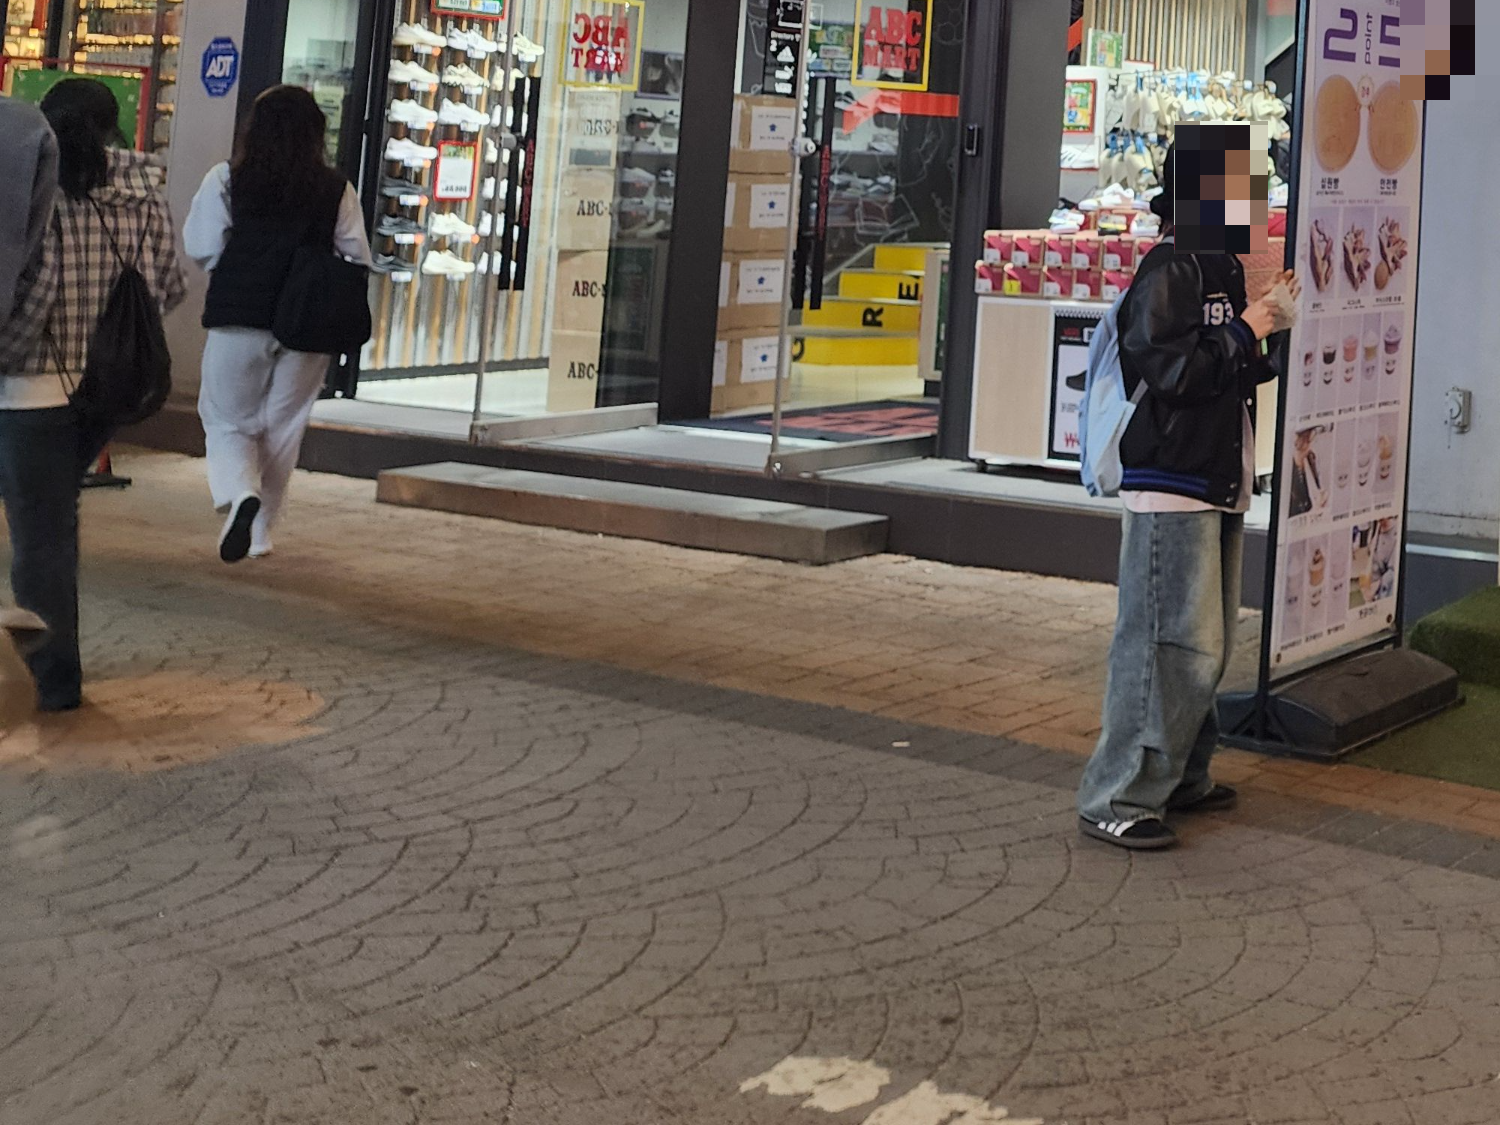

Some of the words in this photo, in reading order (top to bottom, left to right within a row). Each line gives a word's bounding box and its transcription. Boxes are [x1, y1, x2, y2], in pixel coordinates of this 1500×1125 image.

[864, 6, 923, 46] ABC
[205, 55, 235, 79] ADT
[863, 43, 922, 73] MART
